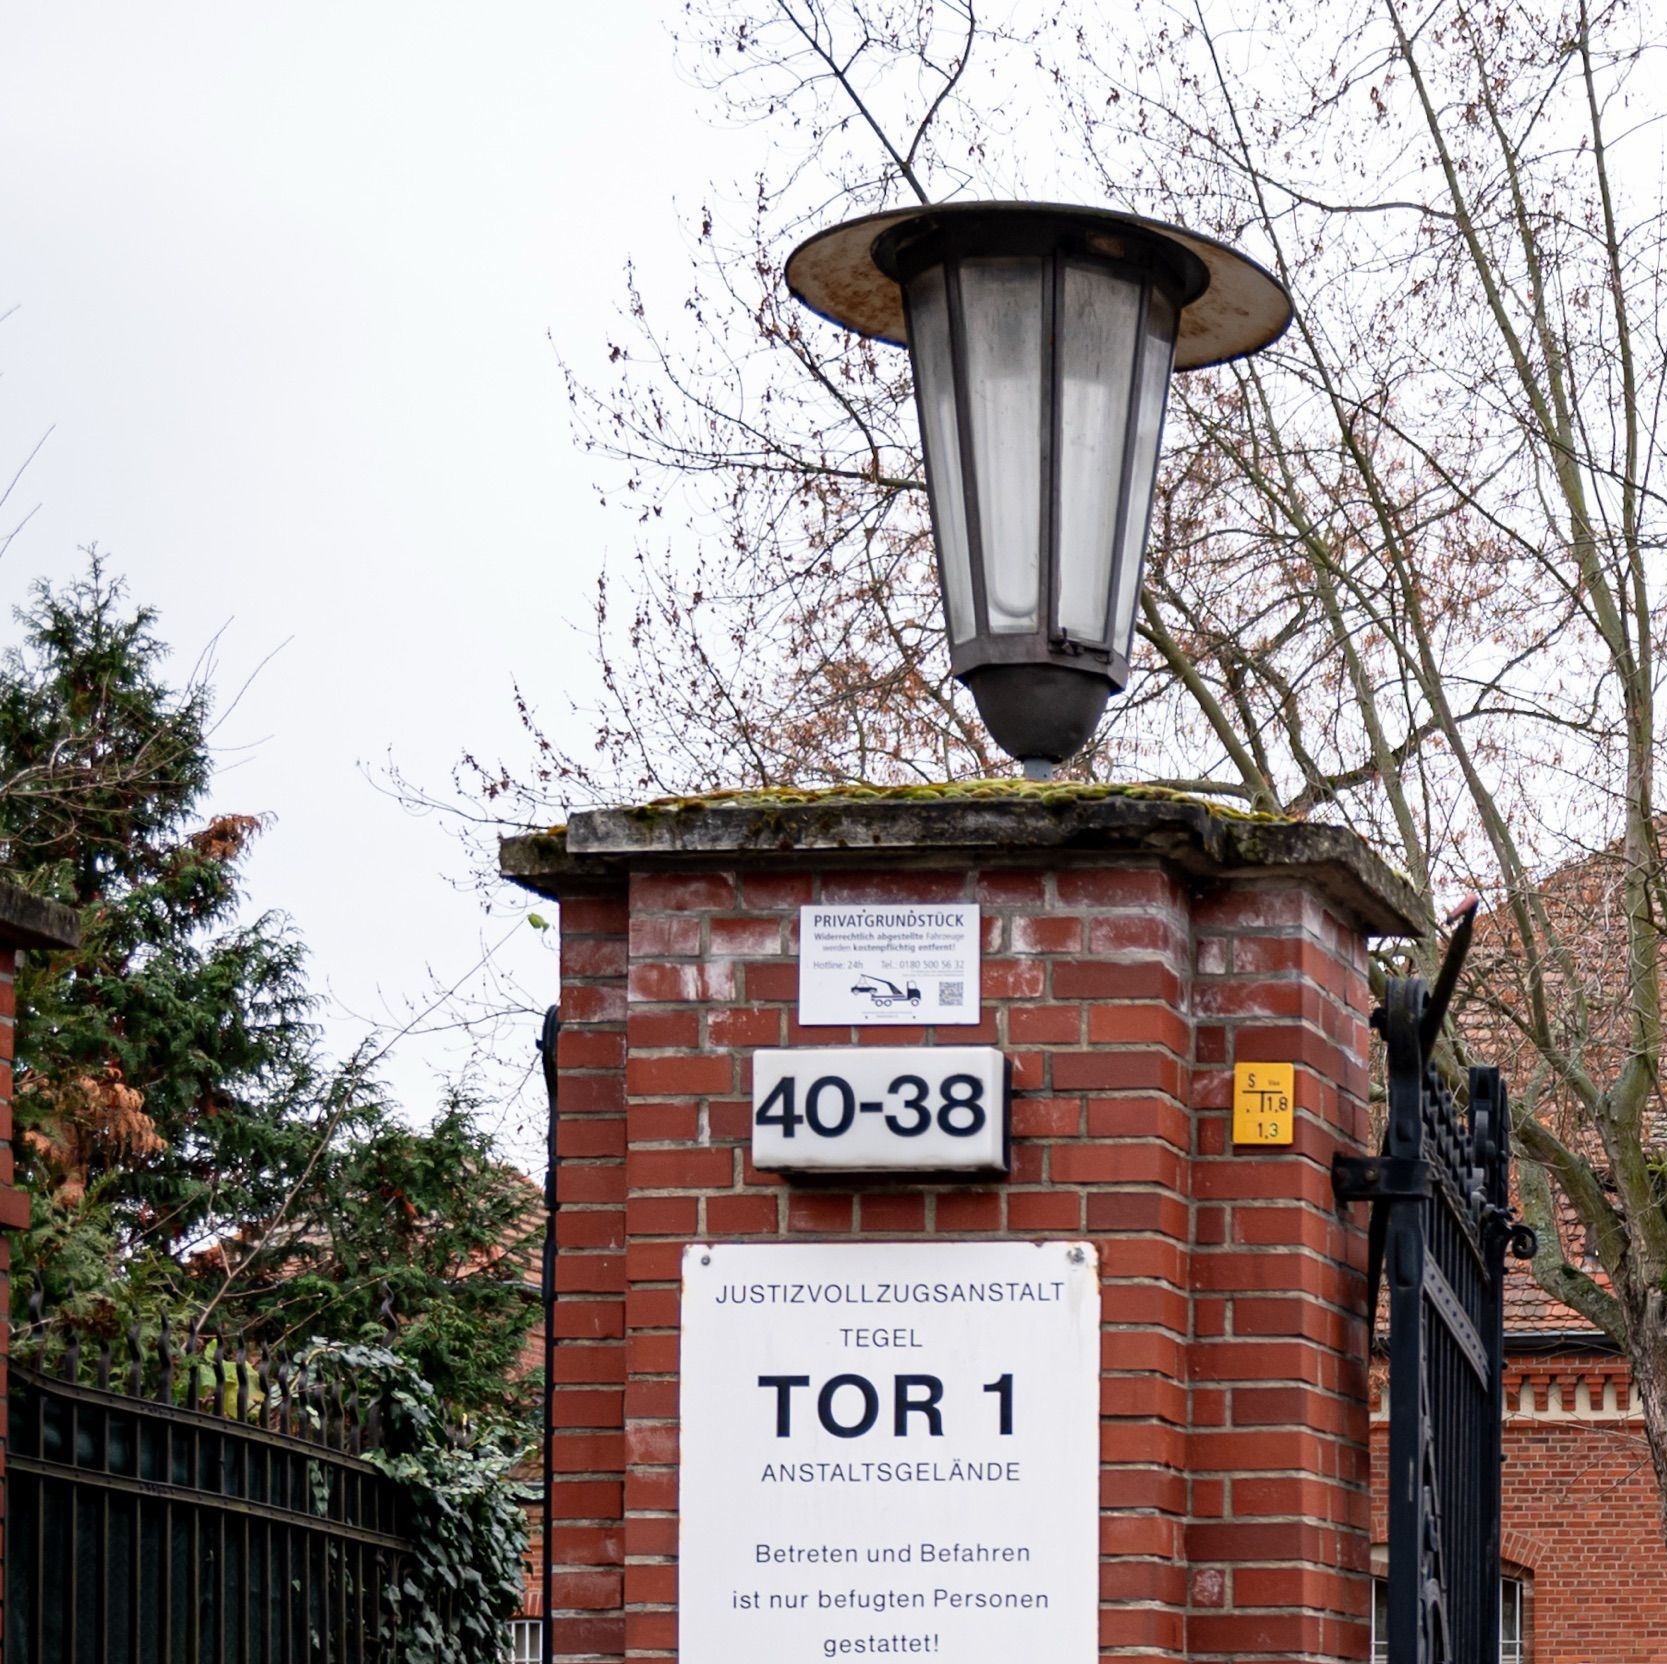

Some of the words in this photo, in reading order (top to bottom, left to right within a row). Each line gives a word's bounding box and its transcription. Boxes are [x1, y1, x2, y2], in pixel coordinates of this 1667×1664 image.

[814, 912, 965, 928] PRIVATGRUNDSTÜCK
[814, 932, 875, 941] Widerrechtlich
[876, 932, 924, 942] abgestellte
[926, 932, 965, 942] Fahrzeuge
[852, 943, 916, 953] kostenpflichtig
[918, 943, 956, 951] entfernt!
[847, 960, 864, 969] 24h
[899, 960, 920, 969] 0180
[923, 960, 939, 969] 500
[941, 960, 952, 969] 56
[954, 960, 965, 969] 32
[1248, 1073, 1256, 1088] S
[755, 1073, 986, 1139] 40-38
[715, 1282, 1064, 1304] JUSTIZVOLLZUGSANSTALT
[839, 1328, 923, 1348] TEGEL
[757, 1373, 944, 1438] TOR
[982, 1373, 1014, 1436] 1
[761, 1459, 1021, 1482] ANSTALTSGELÄNDE
[755, 1544, 858, 1563] Betreten
[866, 1543, 911, 1562] und
[920, 1543, 1030, 1562] Befahren
[732, 1591, 760, 1609] ist
[769, 1594, 809, 1608] nur
[818, 1590, 925, 1612] befugten
[933, 1589, 1049, 1608] Personen
[822, 1634, 939, 1658] gestattet!
